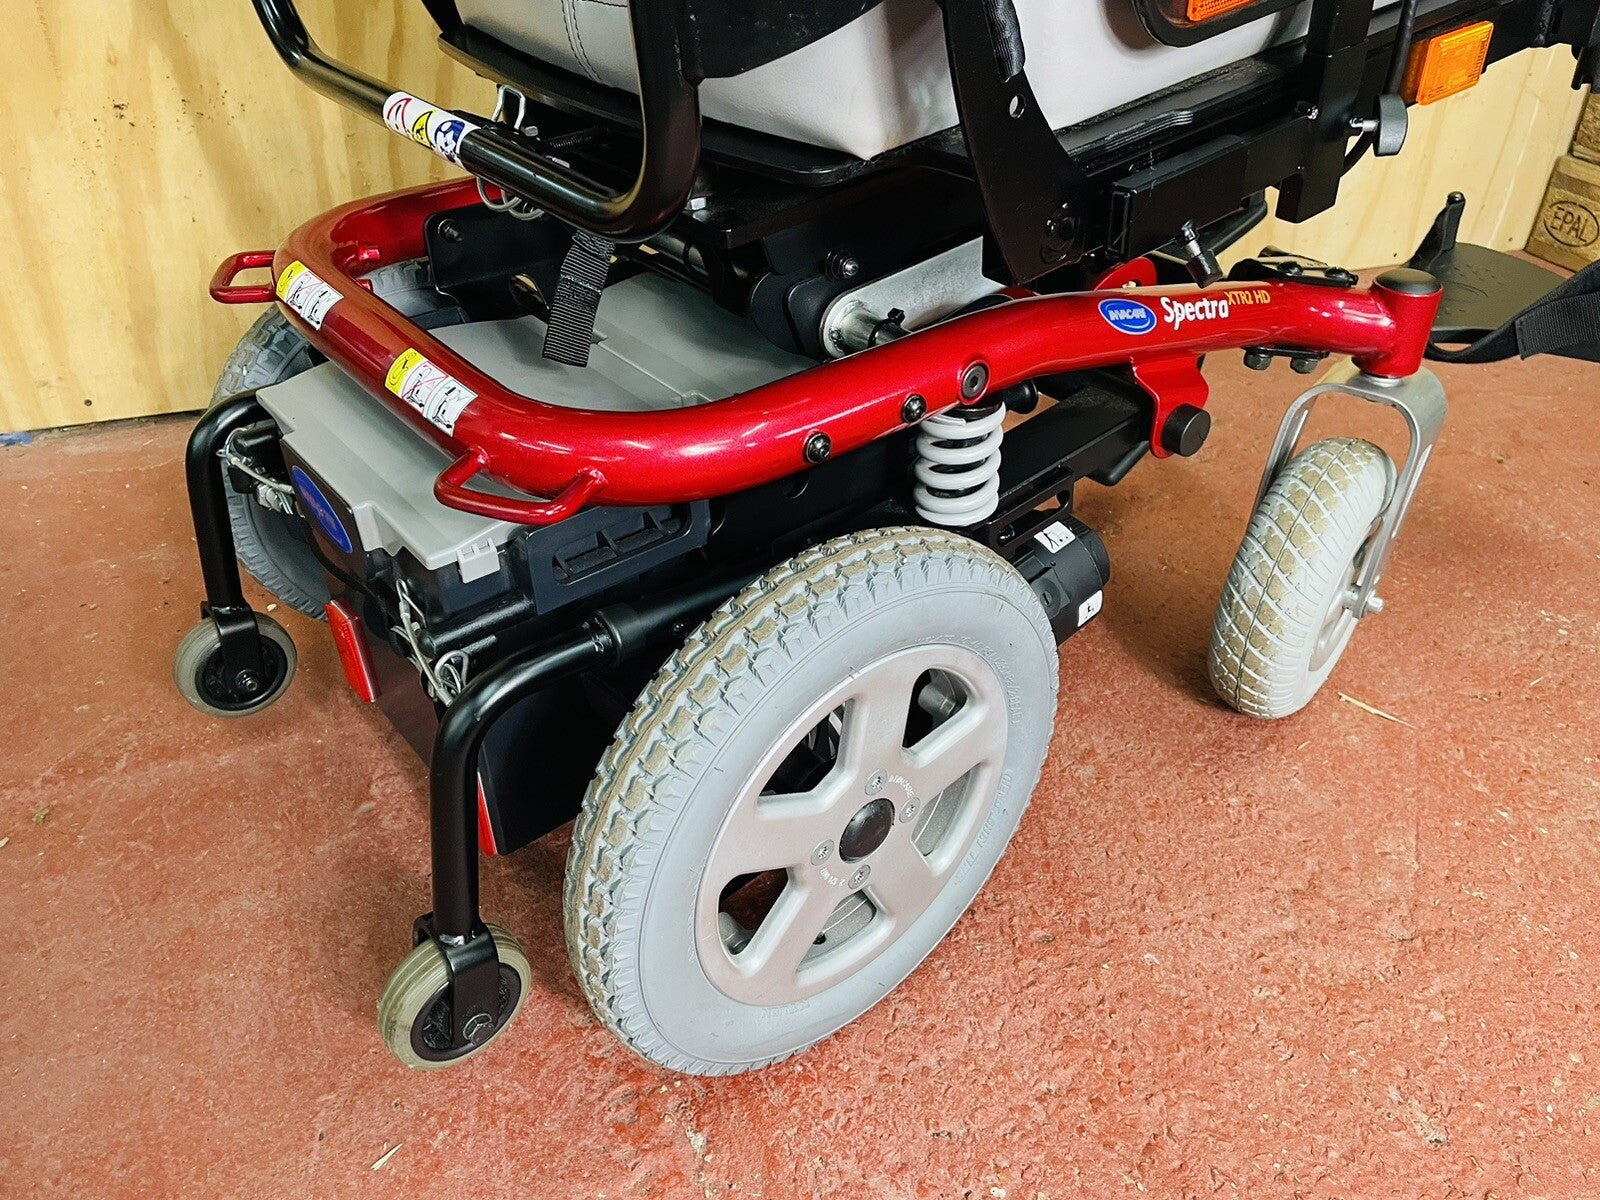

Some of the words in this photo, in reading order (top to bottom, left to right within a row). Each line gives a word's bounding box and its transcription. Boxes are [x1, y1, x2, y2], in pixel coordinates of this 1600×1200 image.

[1550, 206, 1588, 243] EPAL
[1108, 307, 1147, 321] INVACARE
[1160, 296, 1229, 331] Spectra
[1225, 290, 1254, 306] XTR2
[1255, 289, 1271, 304] HD
